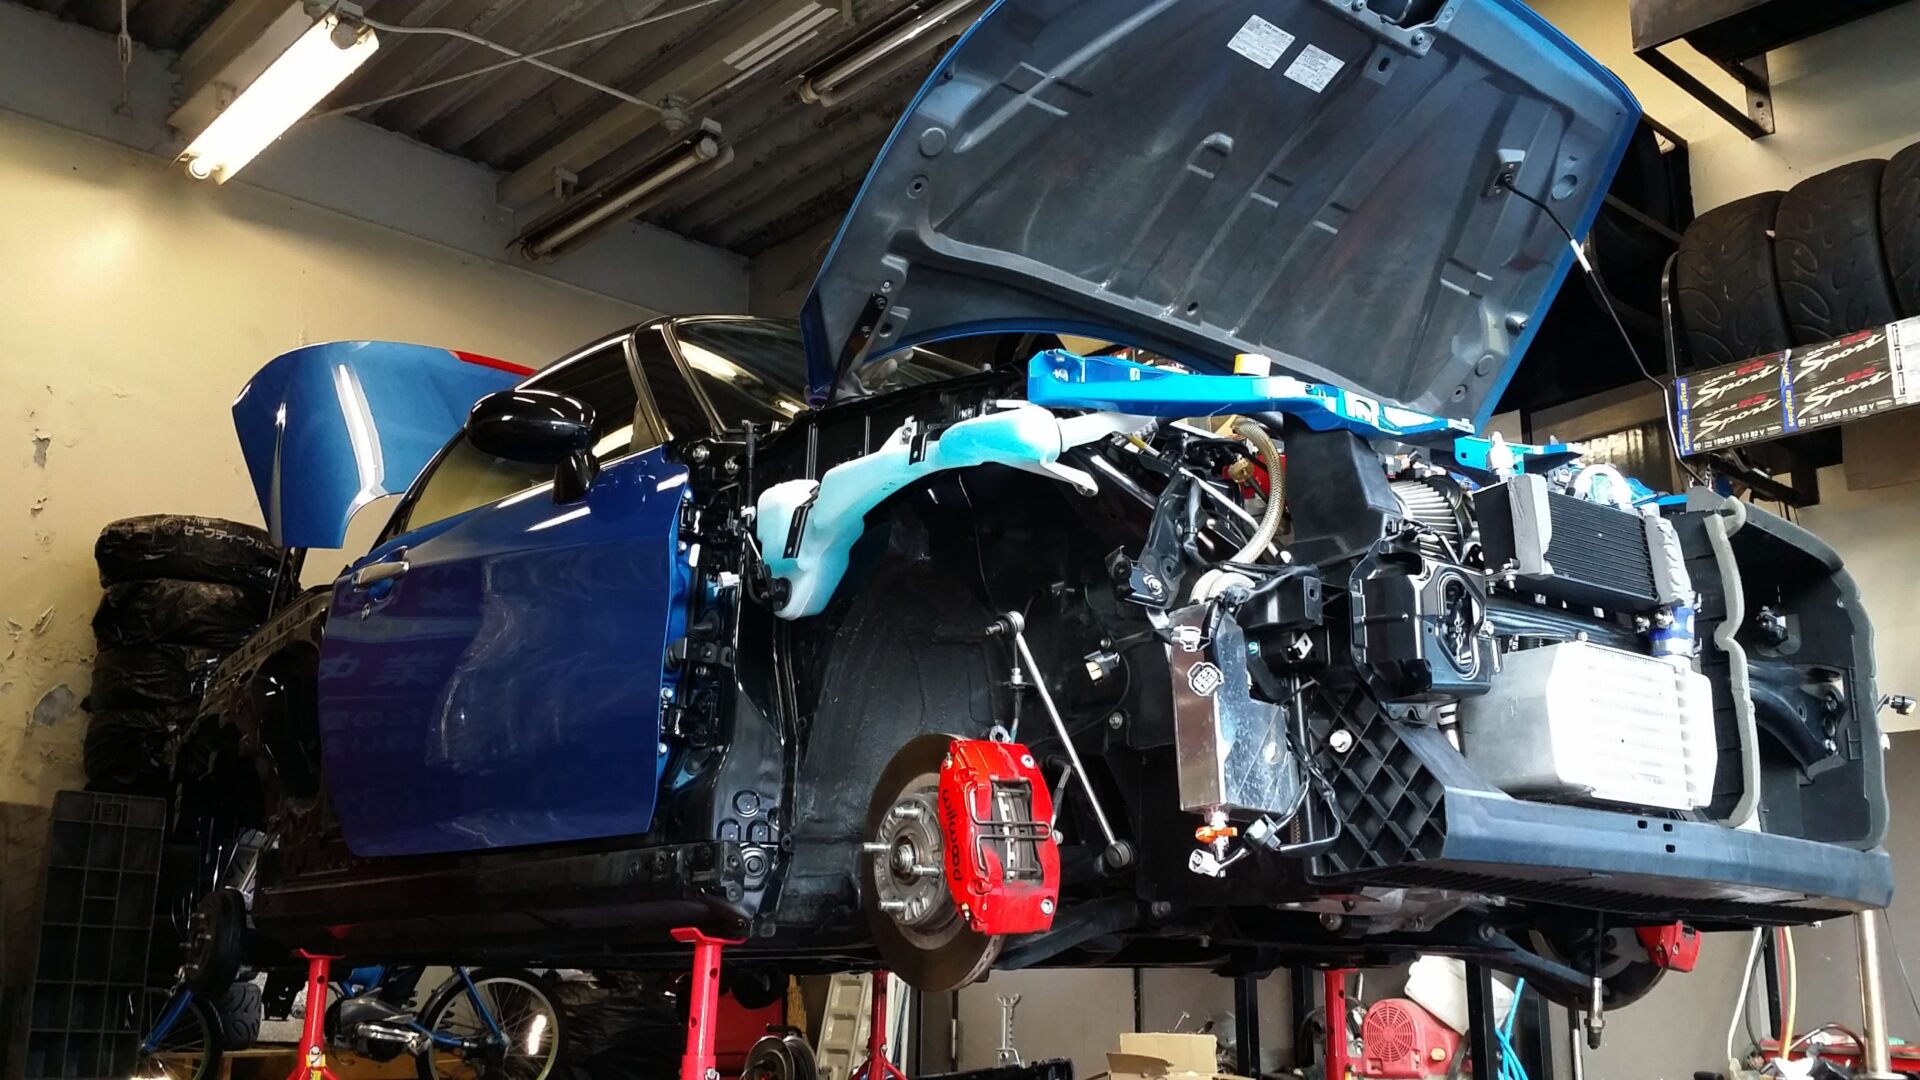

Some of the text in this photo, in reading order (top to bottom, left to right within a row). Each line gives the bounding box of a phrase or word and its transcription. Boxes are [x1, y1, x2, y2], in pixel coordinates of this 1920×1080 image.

[1793, 333, 1887, 384] Sport
[1691, 364, 1780, 410] Sport
[1797, 371, 1891, 419] Sport
[1693, 397, 1782, 442] Sport
[1842, 407, 1849, 415] R
[942, 789, 963, 882] wilwood
